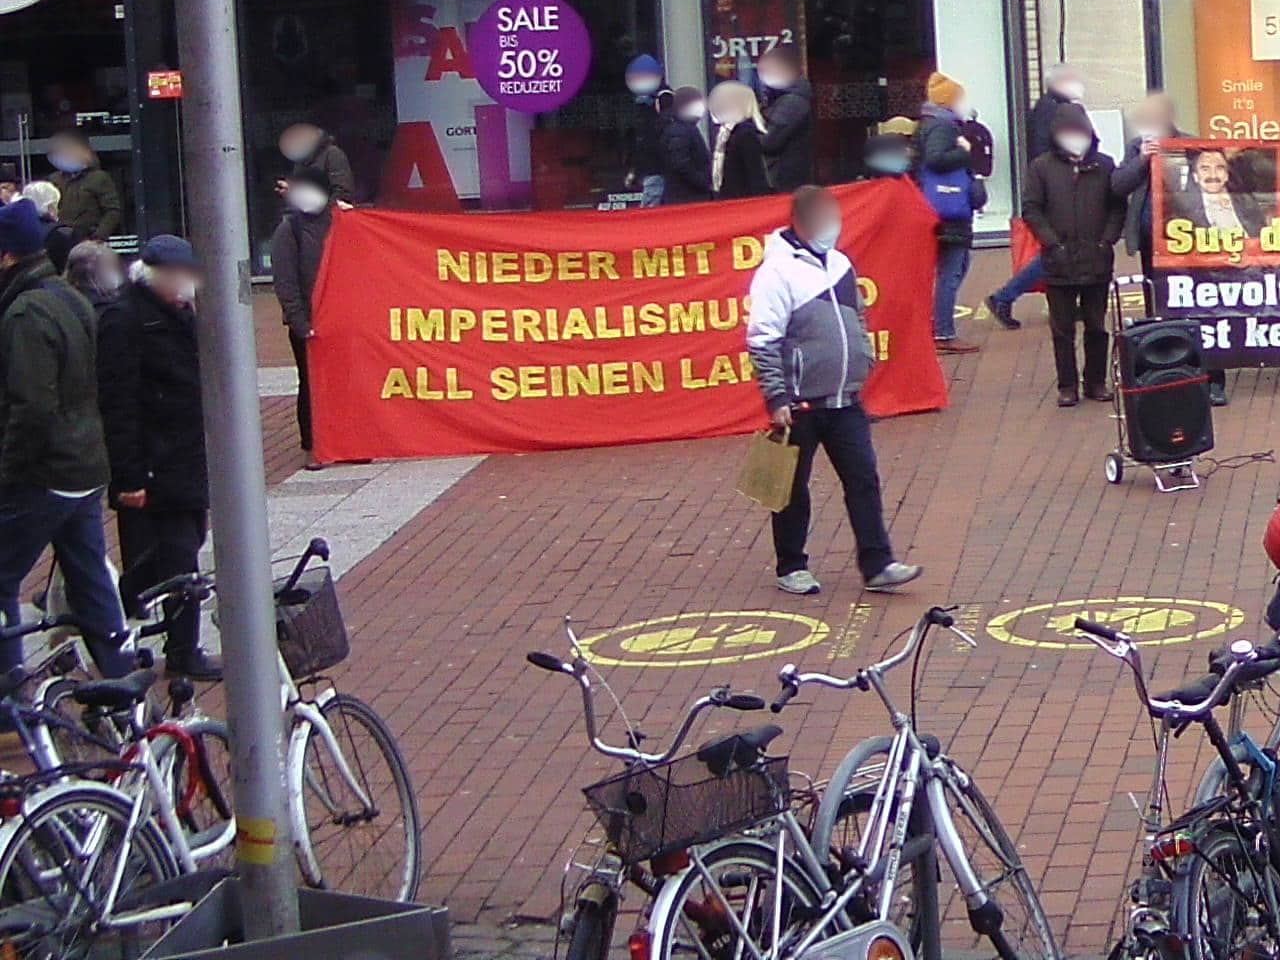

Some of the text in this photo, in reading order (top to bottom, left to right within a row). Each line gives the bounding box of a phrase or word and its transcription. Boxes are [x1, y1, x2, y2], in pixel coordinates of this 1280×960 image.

[497, 6, 559, 31] SALE
[499, 34, 519, 48] BIS
[497, 49, 563, 79] 50%
[500, 79, 562, 94] REDUZIERT
[1221, 79, 1264, 93] Smile
[1208, 113, 1280, 140] Sale
[1165, 218, 1246, 263] Suç
[437, 235, 764, 284] NIEDER MIT D
[381, 367, 473, 400] ALL
[490, 360, 665, 401] SEINEN
